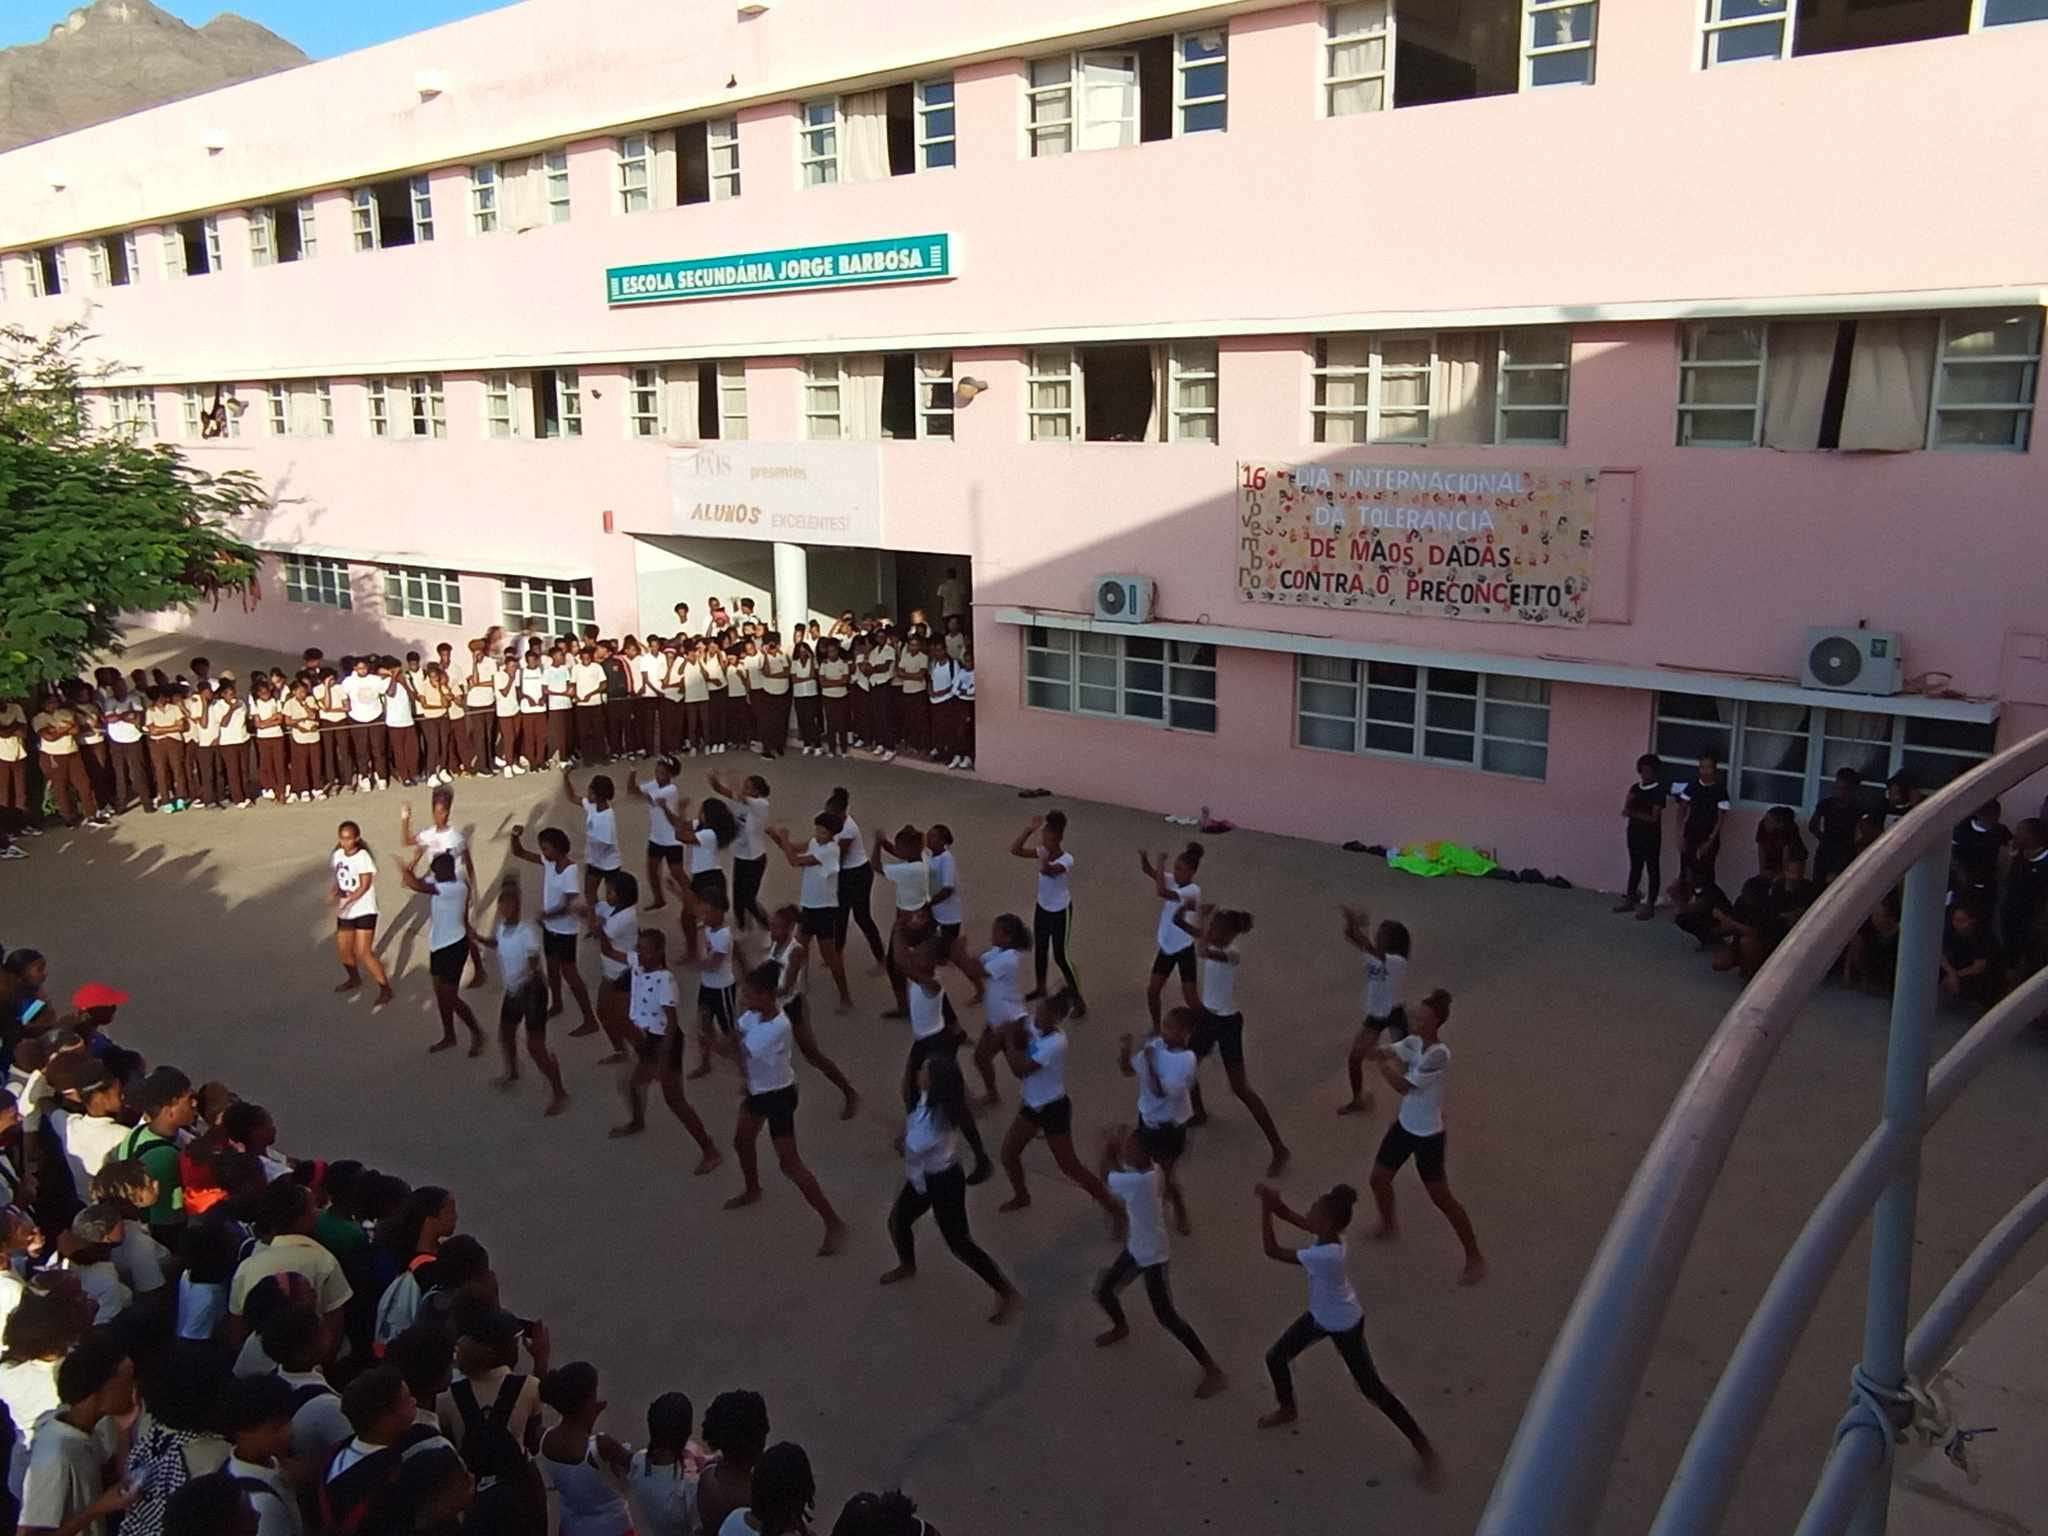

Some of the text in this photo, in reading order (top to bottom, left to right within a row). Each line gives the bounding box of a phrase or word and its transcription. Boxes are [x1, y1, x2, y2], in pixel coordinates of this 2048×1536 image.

[622, 247, 924, 294] ESCOLA SECUNDÁRIA JORGE BARBOSA
[1242, 465, 1267, 491] 16
[1295, 467, 1524, 493] DIA INTERNACIONAL
[690, 502, 763, 525] ALUNOS
[1315, 506, 1346, 528] DA
[1310, 538, 1337, 559] DE
[1429, 544, 1511, 568] DADAS
[1280, 569, 1561, 608] CONTRA O PRECONCEITO
